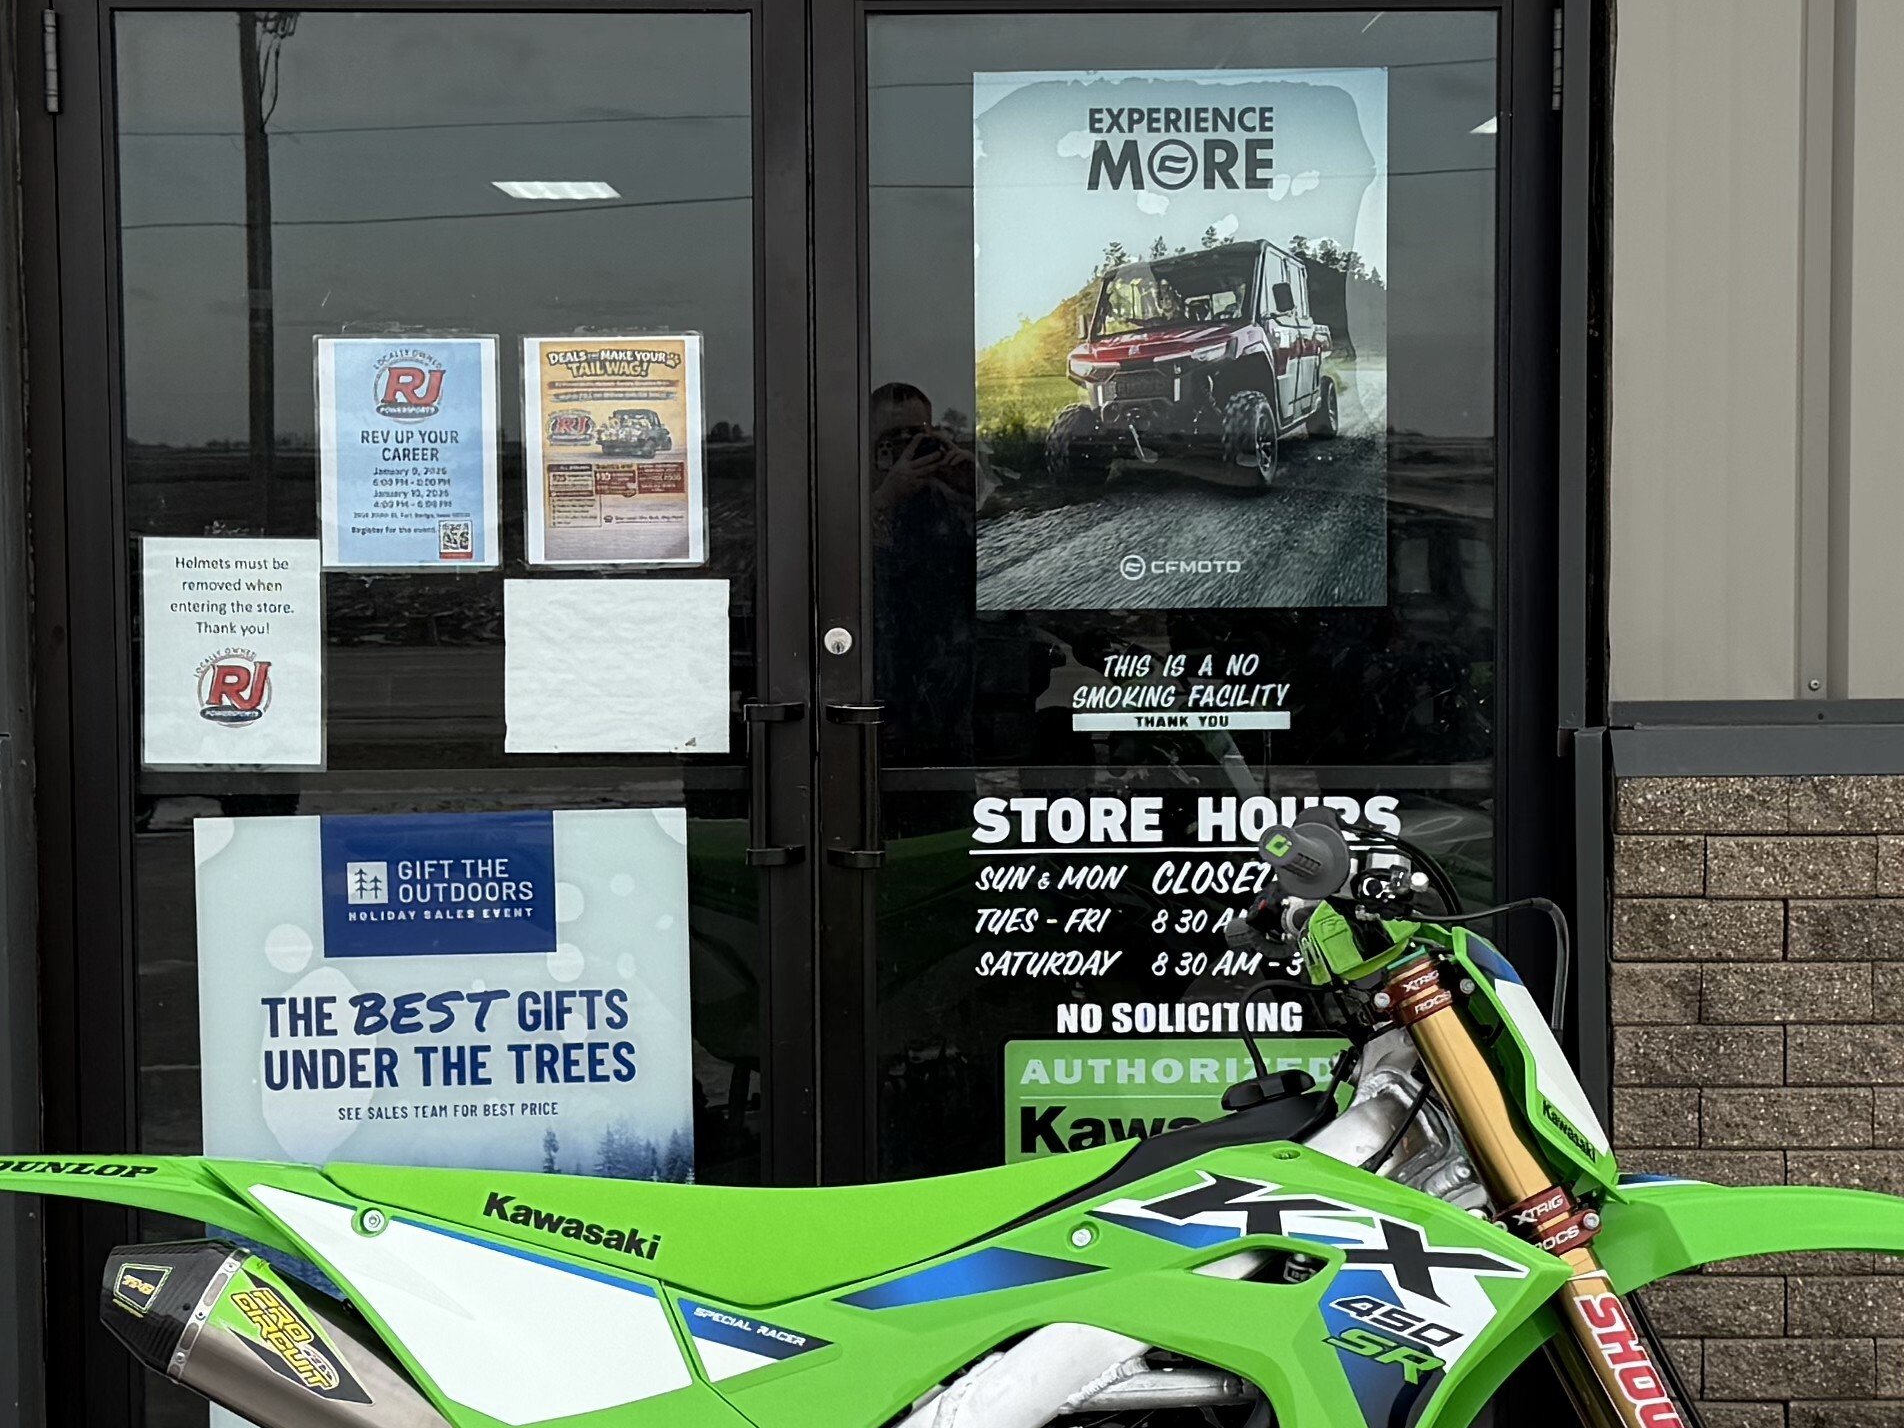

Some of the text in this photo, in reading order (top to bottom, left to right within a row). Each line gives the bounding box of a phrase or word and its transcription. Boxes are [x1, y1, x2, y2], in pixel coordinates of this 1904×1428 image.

[1088, 106, 1274, 134] EXPERIENCE
[1086, 138, 1274, 191] MORE
[548, 350, 587, 365] DEALS
[600, 349, 633, 361] MAKE
[634, 351, 667, 363] YOUR
[568, 361, 649, 378] TAIL WAG!
[381, 366, 446, 407] RJ
[361, 430, 459, 444] REV UP YOUR
[382, 447, 439, 462] CAREER
[175, 556, 289, 570] Helmets must be
[1150, 559, 1242, 575] CFMOTO
[182, 579, 283, 592] removed when
[170, 600, 295, 615] entering the store.
[196, 621, 270, 636] Thank you!
[1104, 653, 1260, 678] THIS IS A NO
[206, 661, 272, 711] RJ
[1072, 682, 1291, 709] SMOKING FACILITY
[1134, 715, 1230, 728] THANK YOU
[972, 796, 1164, 845] STORE
[398, 858, 509, 880] GIFT THE
[975, 864, 1036, 893] SUN
[1057, 864, 1129, 891] MON
[399, 881, 533, 903] OUTDOORS
[348, 907, 533, 922] HOLIDAY SALES EVENT
[975, 907, 1040, 935] TUES
[1064, 907, 1112, 934] FRI
[975, 949, 1123, 978] SATURDAY
[1212, 950, 1263, 977] AM
[1401, 969, 1440, 992] XTRIG
[261, 988, 629, 1038] THE BEST GIFTS
[1057, 1001, 1303, 1034] NO SOLICITING
[264, 1041, 636, 1091] UNDER THE TREES
[338, 1101, 558, 1121] SEE SALES TEAM FOR BEST PRICE
[1542, 1098, 1596, 1164] Kawasaki
[1511, 1194, 1564, 1226] XTRIG
[482, 1191, 662, 1261] Kawasaki
[1140, 1172, 1530, 1308] KX
[248, 1286, 315, 1344] PRO
[693, 1306, 806, 1347] SPECIAL RACER
[1329, 1295, 1465, 1348] 450
[230, 1291, 334, 1390] CIRCUIT
[1321, 1327, 1447, 1385] SR
